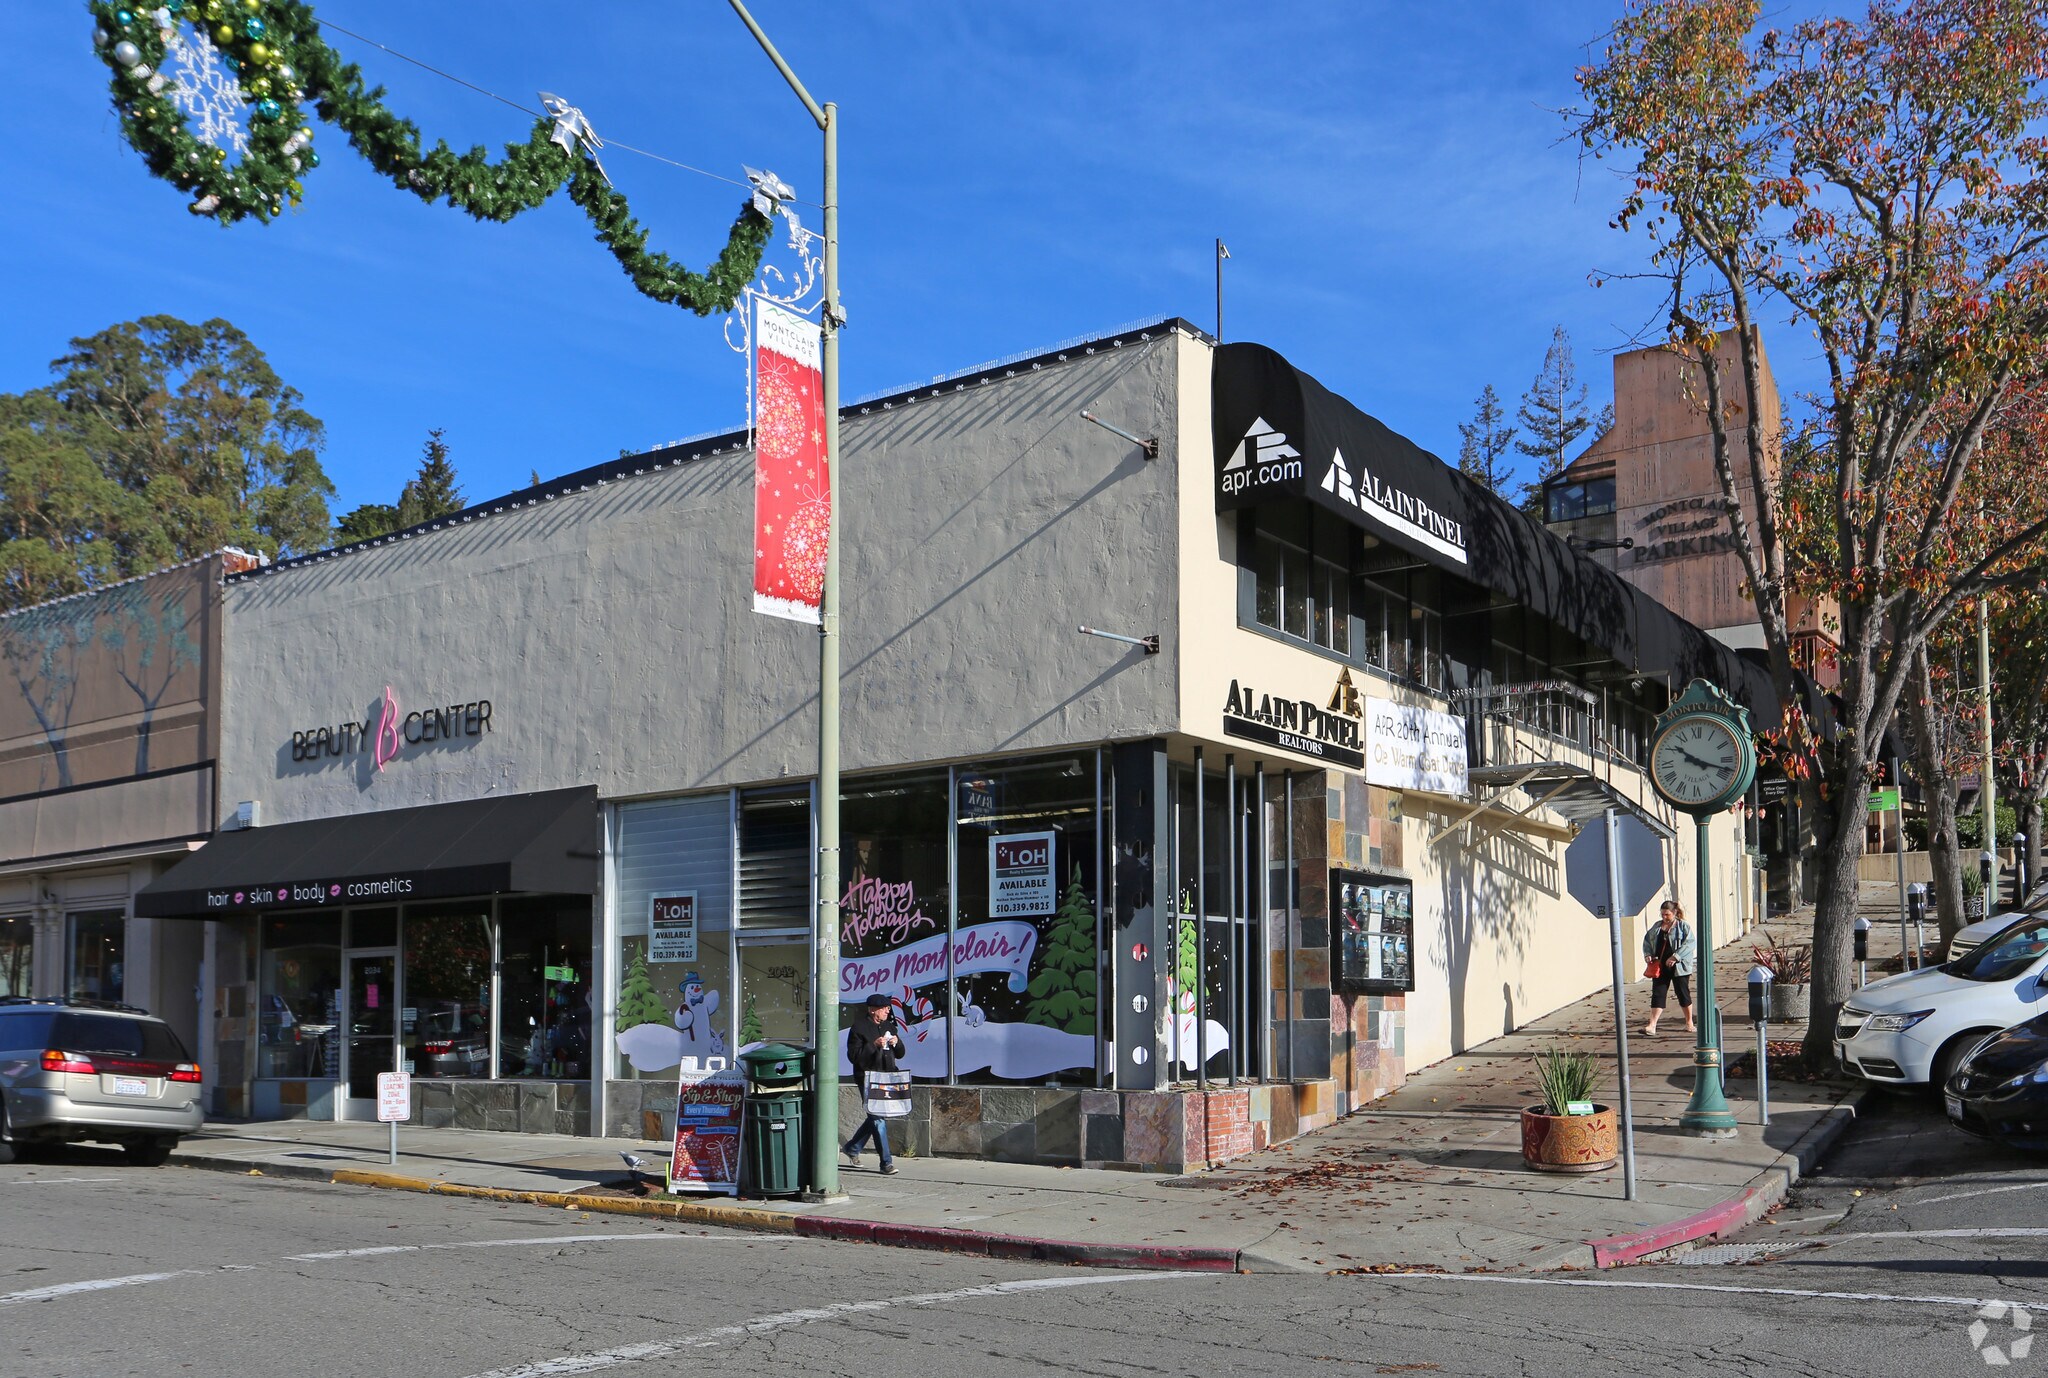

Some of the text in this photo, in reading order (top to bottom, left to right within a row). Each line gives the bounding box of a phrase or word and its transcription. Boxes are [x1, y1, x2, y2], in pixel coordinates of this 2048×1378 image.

[764, 319, 815, 350] MONTCLAIR
[768, 331, 813, 358] VILLAGE
[1221, 460, 1303, 495] apr.com
[1360, 466, 1467, 548] ALAIN PINEL
[1657, 516, 1720, 536] VILLAGE
[1223, 679, 1363, 750] ALAIN PINEL
[1666, 702, 1731, 721] MONTCLAIR
[292, 719, 371, 762] BEAUTY
[403, 699, 492, 745] CENTER
[1374, 713, 1464, 749] APR 20th Annual
[1278, 732, 1323, 756] REALTORS
[1683, 772, 1712, 784] VILLAGE
[1009, 848, 1047, 867] LOH
[207, 878, 413, 907] hair skin body cosmetics
[840, 874, 915, 916] Happy
[998, 879, 1047, 890] AVAILABLE
[663, 904, 692, 919] LOH
[995, 900, 1050, 914] 510.339.9825
[655, 930, 692, 940] AVAILABLE
[841, 908, 936, 946] Holidays
[652, 950, 693, 959] 510.339.9825
[840, 930, 1033, 993] Shop Montclair!
[682, 1087, 742, 1111] Sip & Shop
[686, 1105, 728, 1115] Every Thursday!
